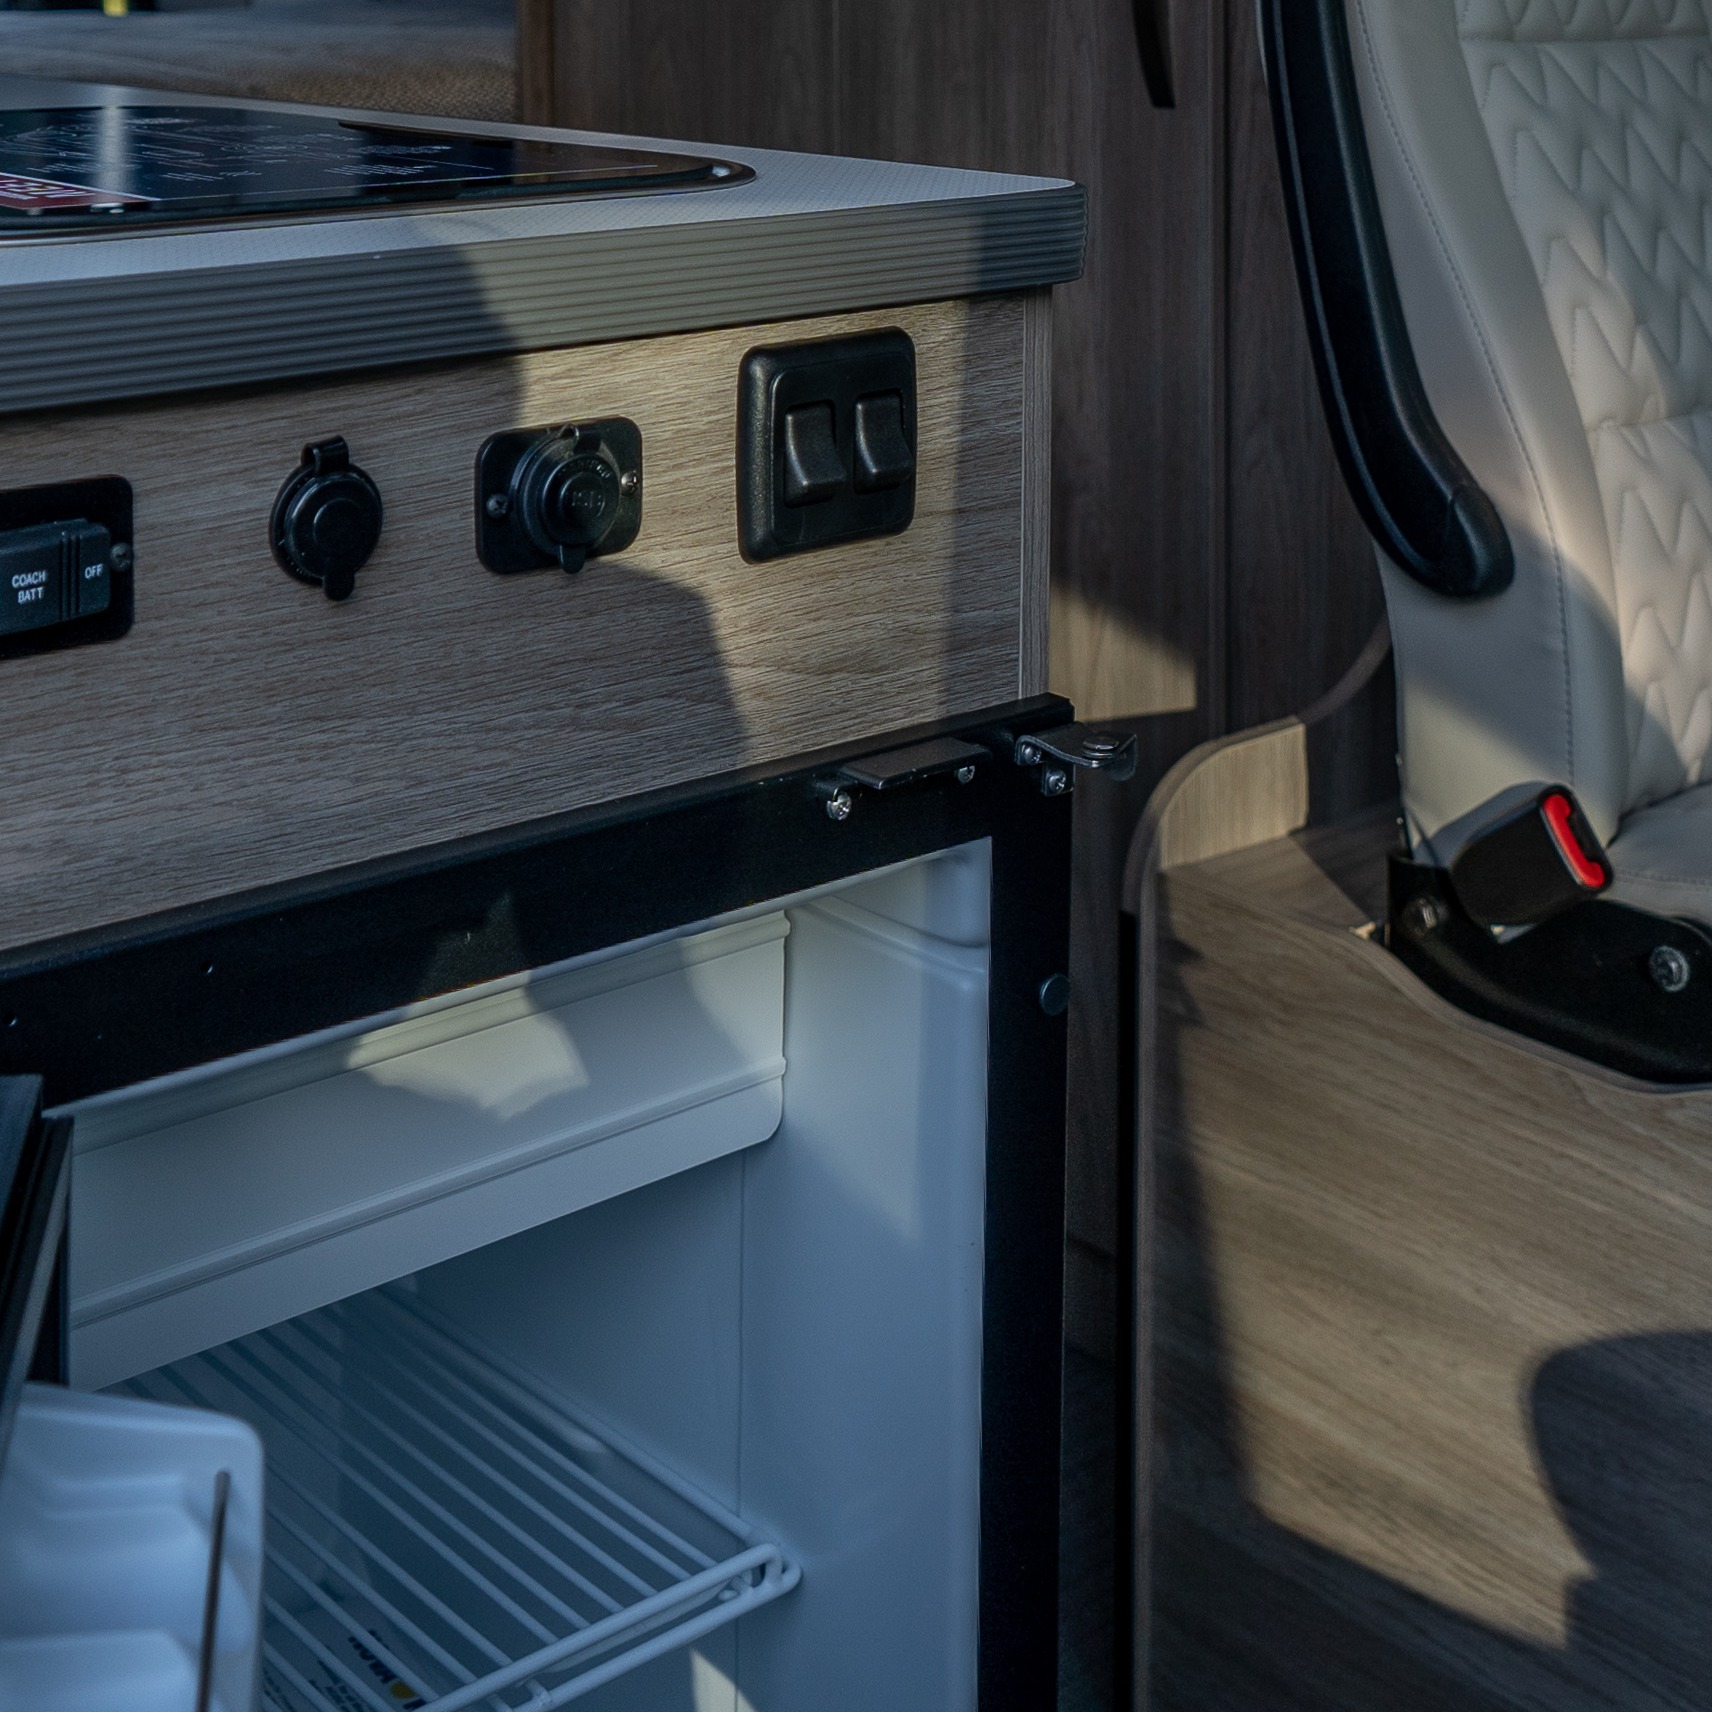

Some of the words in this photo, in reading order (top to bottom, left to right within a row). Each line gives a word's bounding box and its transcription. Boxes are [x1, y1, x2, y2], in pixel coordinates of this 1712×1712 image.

[11, 570, 47, 588] COACH
[84, 563, 103, 579] OFF
[17, 587, 44, 604] BATT
